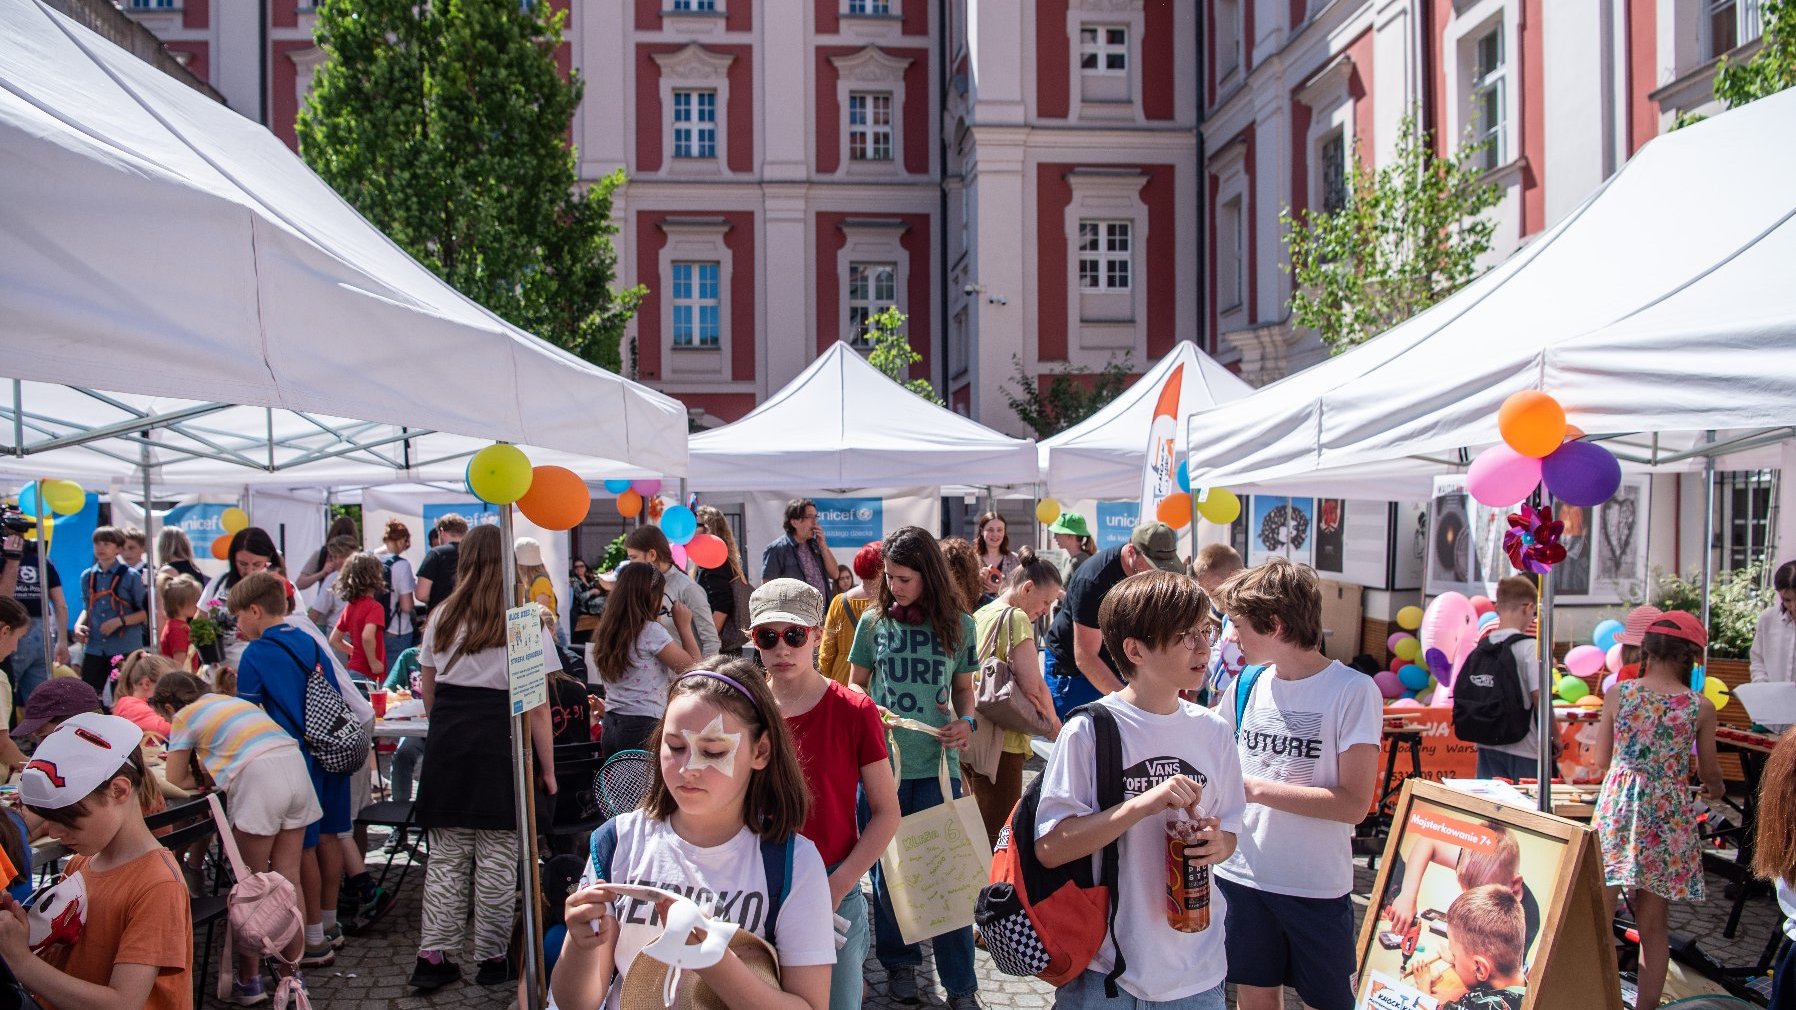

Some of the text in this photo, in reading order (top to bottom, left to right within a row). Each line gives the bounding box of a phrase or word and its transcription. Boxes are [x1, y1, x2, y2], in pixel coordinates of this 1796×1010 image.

[873, 629, 948, 657] SUPE
[1144, 758, 1181, 776] VANS
[1410, 813, 1492, 846] Majsterkowanie 7+
[1377, 993, 1401, 1009] KNOCK
